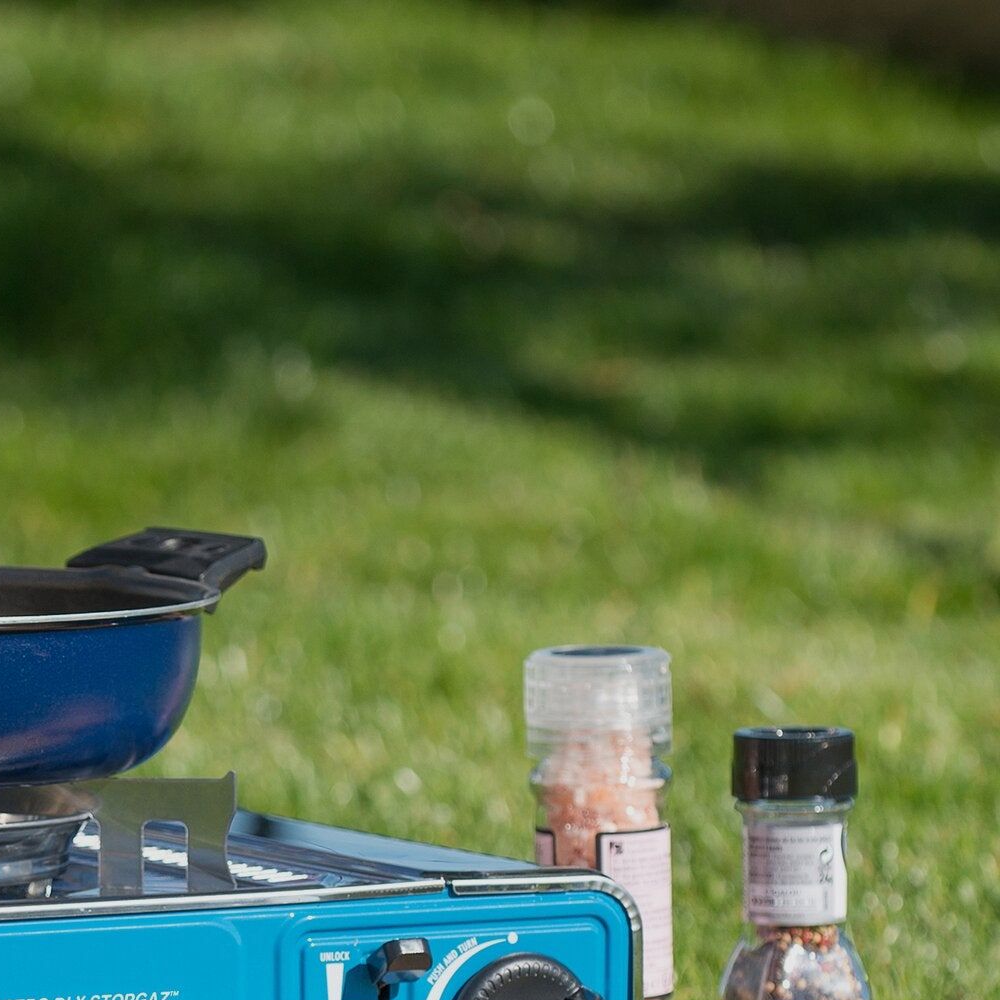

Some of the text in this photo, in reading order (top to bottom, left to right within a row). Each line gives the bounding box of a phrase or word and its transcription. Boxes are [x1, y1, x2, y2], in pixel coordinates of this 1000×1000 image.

[320, 951, 350, 962] UNLOCK
[427, 936, 478, 985] PUSH AND TURN
